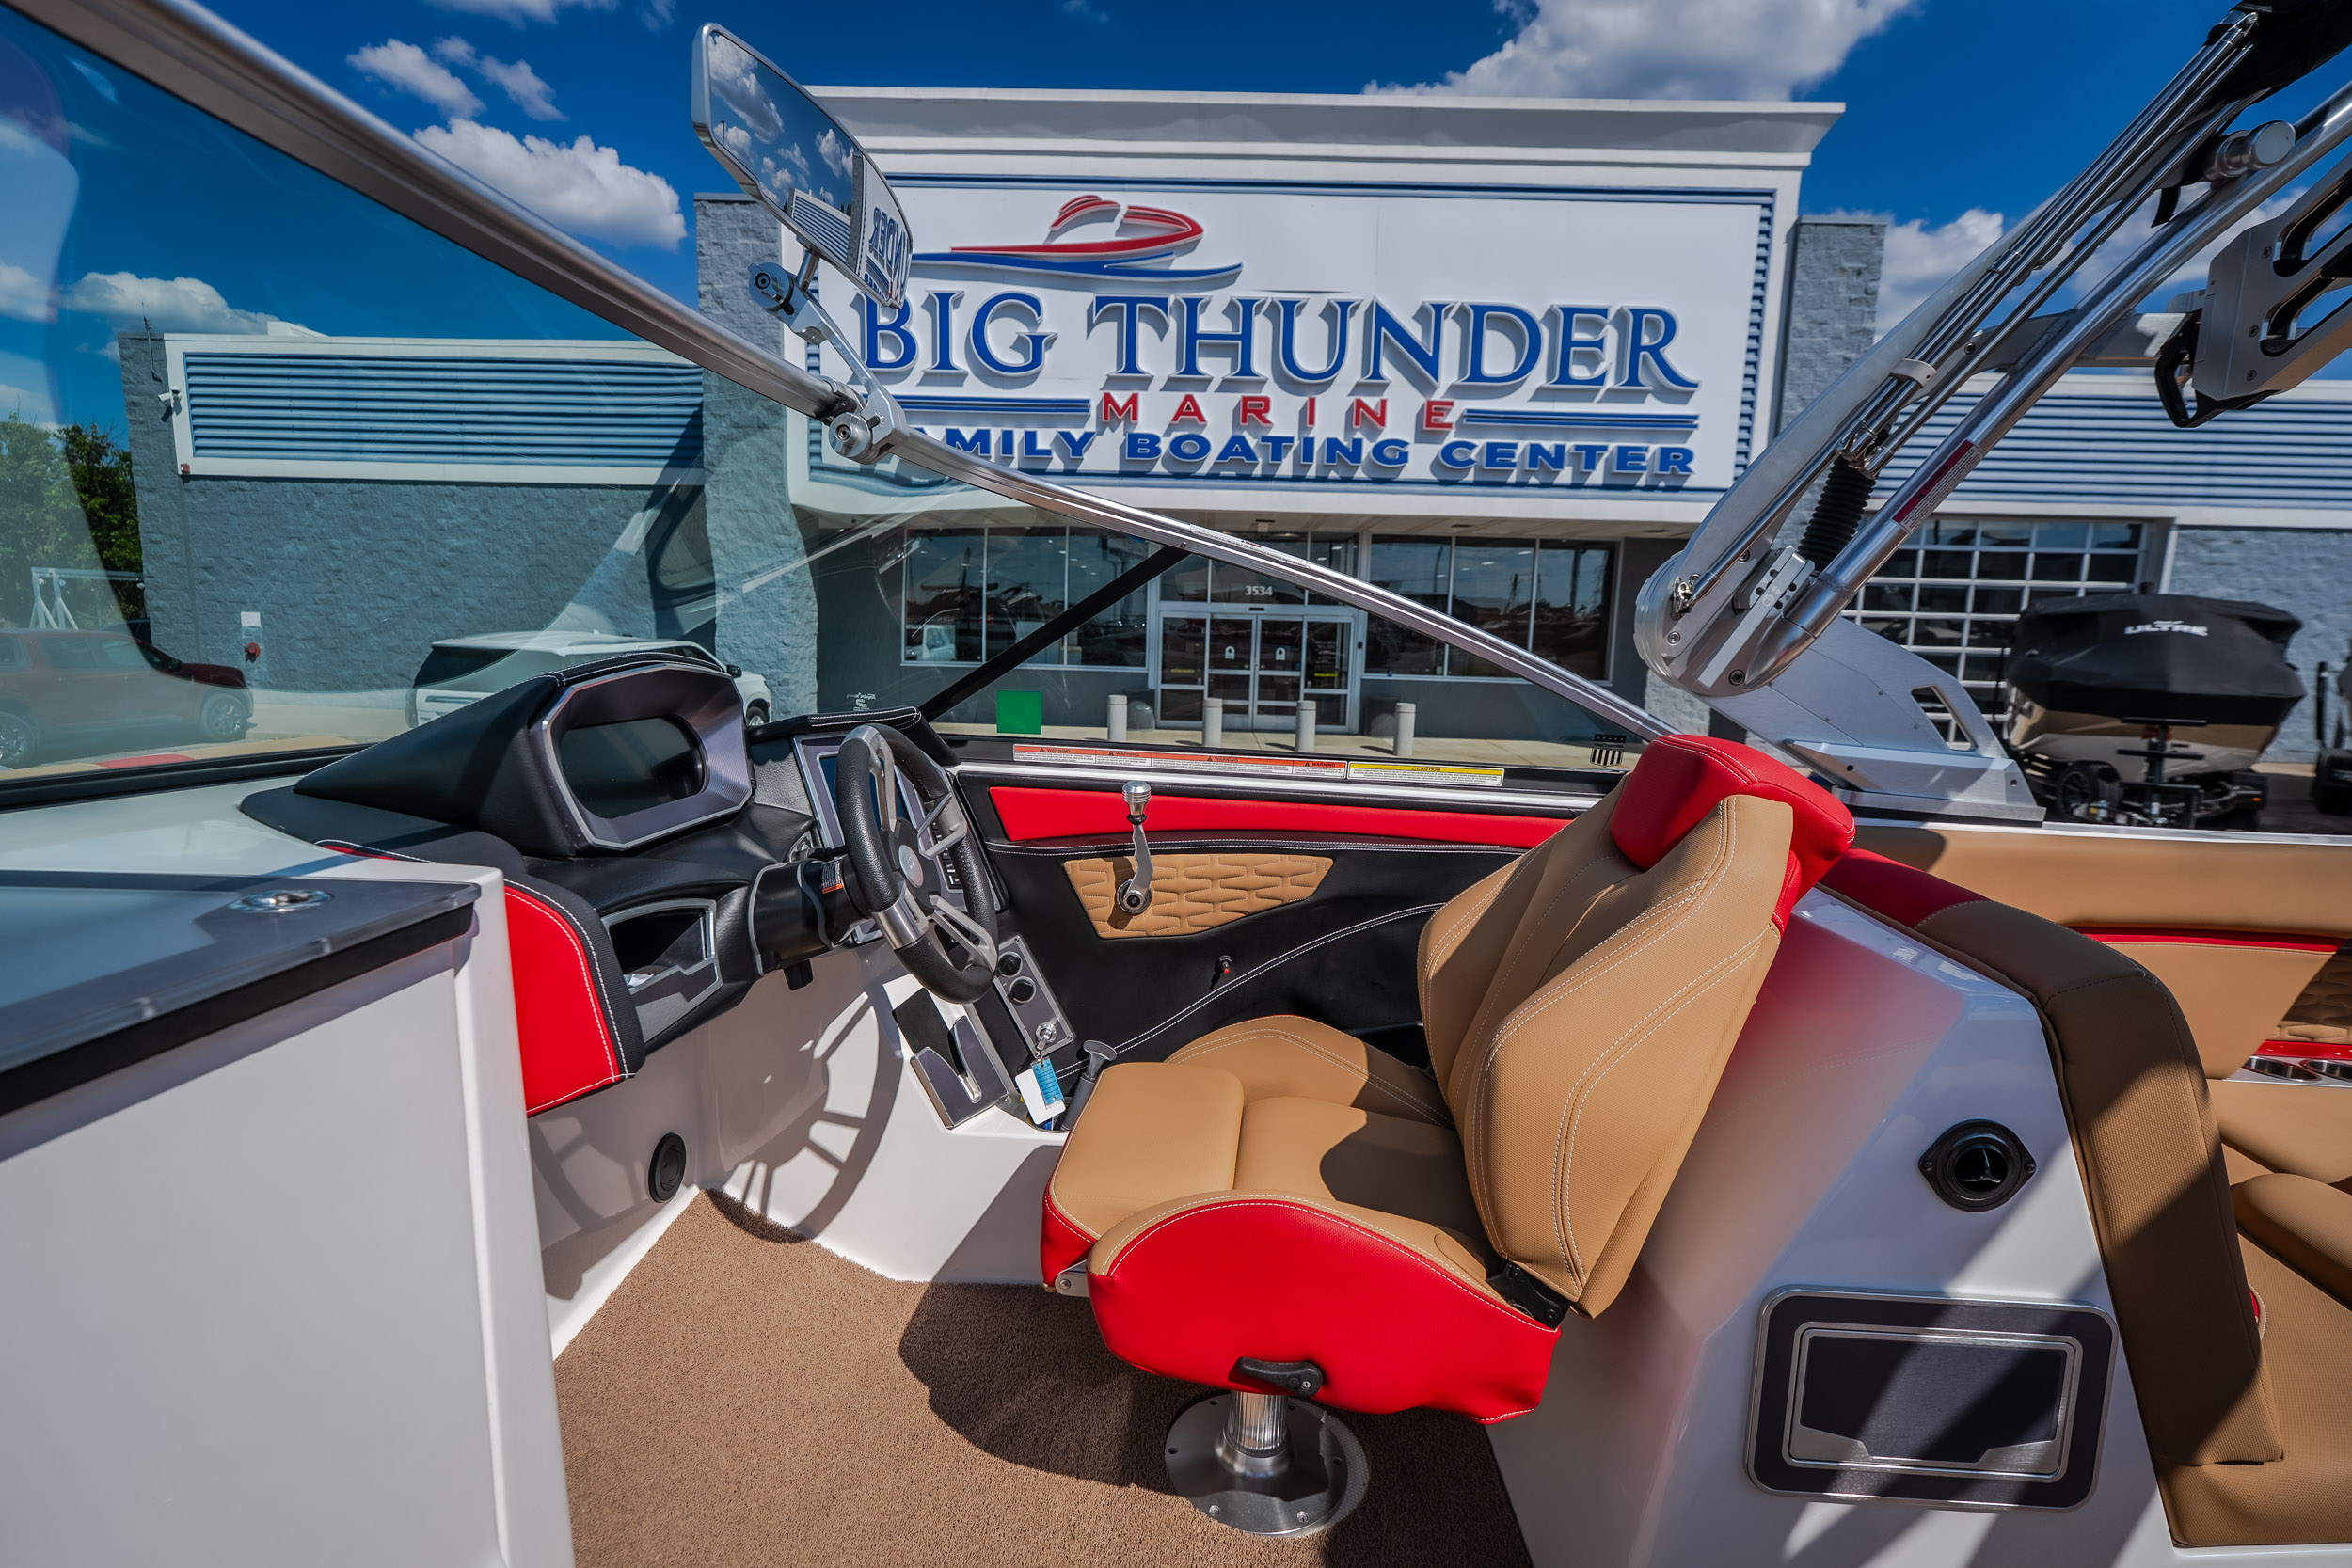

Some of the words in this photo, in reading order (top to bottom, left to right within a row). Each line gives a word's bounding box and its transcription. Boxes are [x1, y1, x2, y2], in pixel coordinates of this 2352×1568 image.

[856, 289, 1059, 376] BIG
[1092, 293, 1701, 391] THUNDER
[1102, 391, 1455, 432] MARINE
[910, 426, 1097, 459] MILY
[1125, 432, 1410, 467] BOATING
[1439, 439, 1696, 475] CENTER
[1245, 585, 1273, 596] 3534
